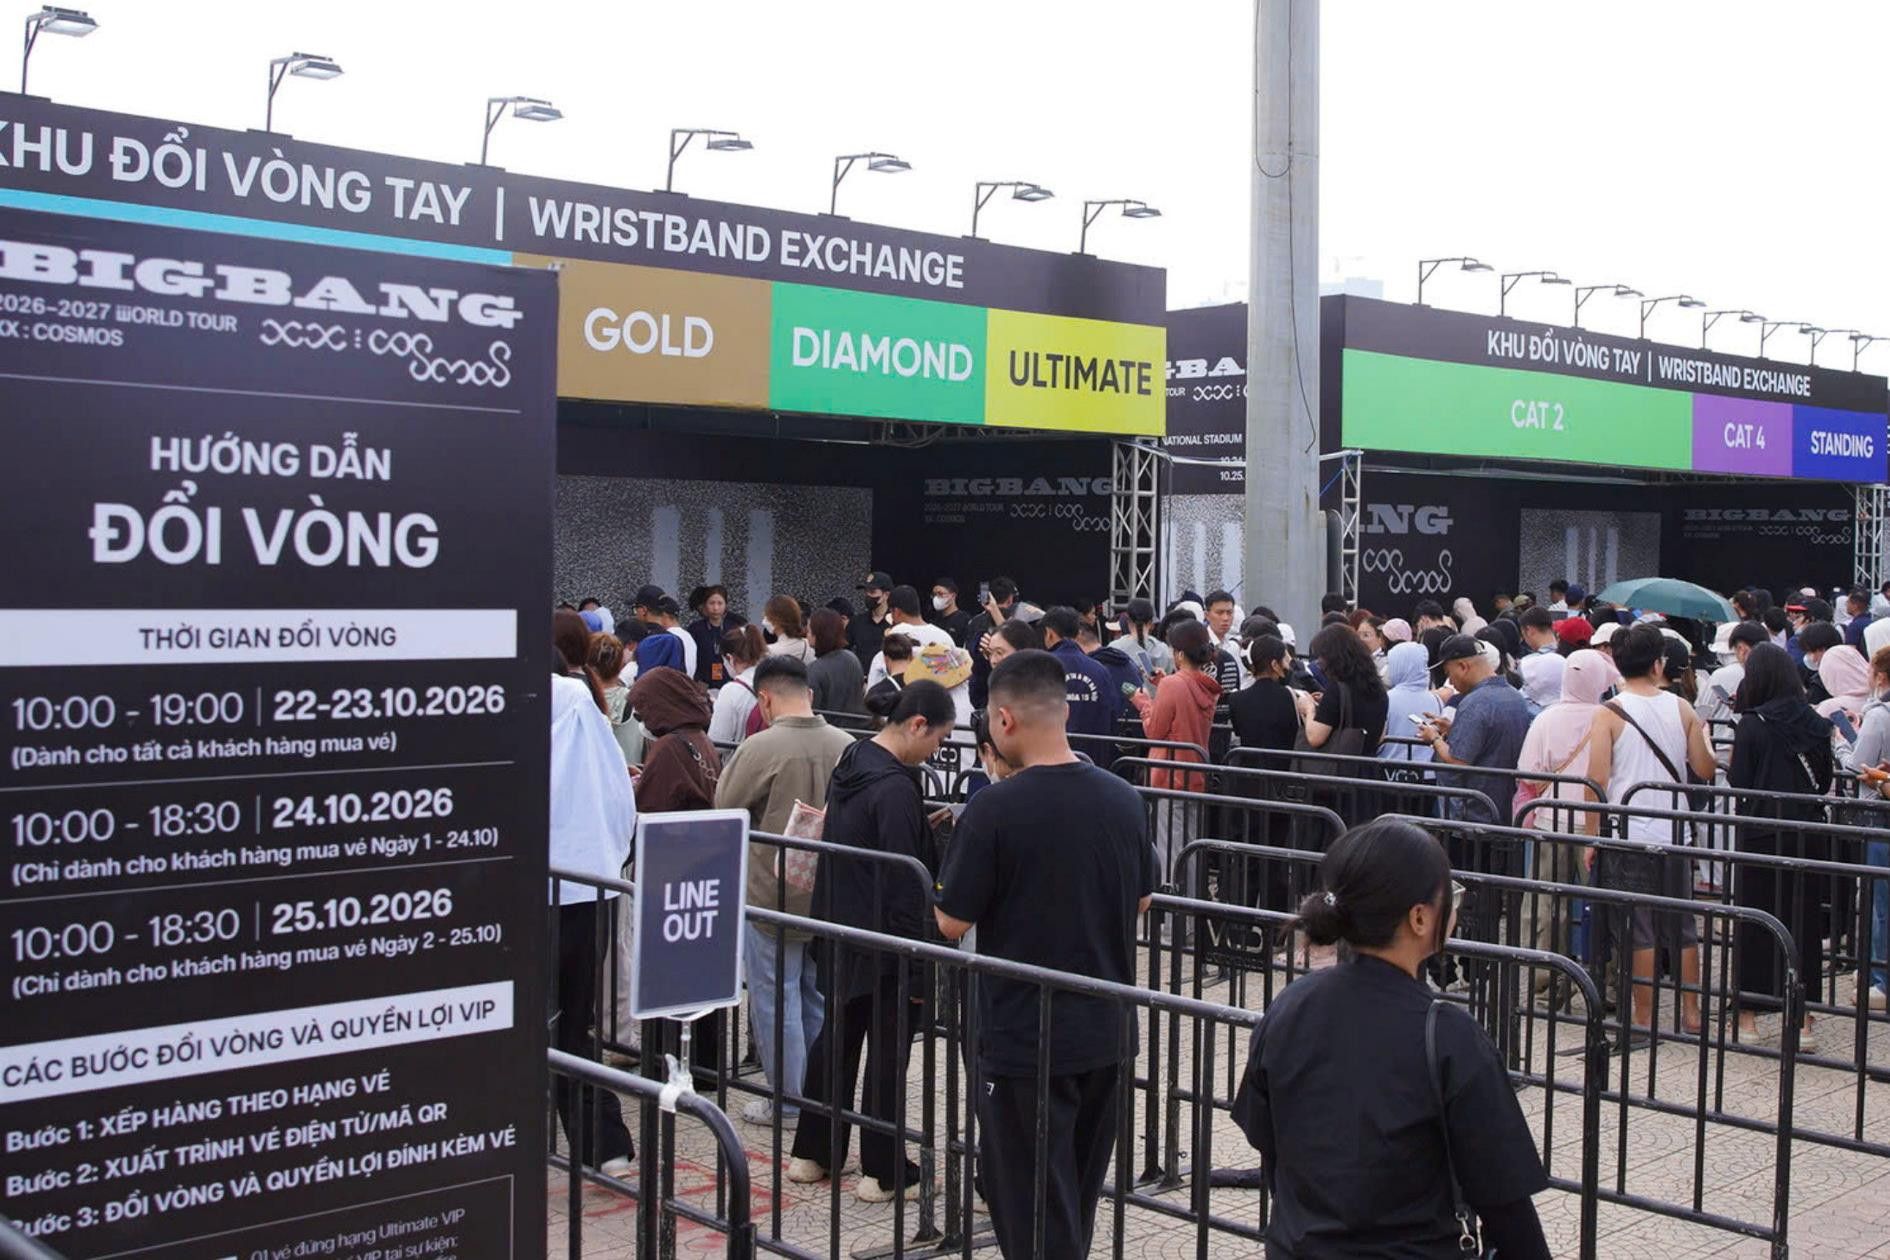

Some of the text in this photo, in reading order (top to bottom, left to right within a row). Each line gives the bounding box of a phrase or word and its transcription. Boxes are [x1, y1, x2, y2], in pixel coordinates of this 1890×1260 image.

[109, 127, 206, 191] ĐỔI
[222, 148, 371, 214] VÒNG
[384, 177, 472, 226] TAY
[528, 197, 771, 262] WRISTBAND
[779, 231, 965, 289] EXCHANGE
[0, 240, 524, 329] BIGBANG
[0, 293, 110, 321] 026-2027
[186, 311, 238, 332] TOUR
[583, 307, 715, 359] GOLD
[792, 327, 974, 382] DIAMOND
[1009, 350, 1152, 396] ULTIMATE
[1487, 329, 1526, 359] KHU
[1529, 327, 1559, 363] ĐỔI
[1563, 336, 1610, 371] VÒNG
[1613, 347, 1641, 375] TAY
[1658, 355, 1742, 390] WRISTBAND
[1743, 368, 1812, 397] EXCHANGE
[1203, 433, 1243, 445] STADIUM
[1510, 399, 1565, 432] CAT 2
[1724, 422, 1766, 450] CAT 4
[150, 431, 391, 480] HƯỚNG DẪN
[1810, 430, 1875, 459] STANDING
[924, 477, 1114, 496] BIGBANG
[89, 481, 439, 568] ĐỔI VÒNG
[1683, 509, 1851, 521] BIGBANG
[139, 618, 397, 650] THỜI GIAN ĐỔI VÒNG
[13, 695, 116, 731] 10:00
[150, 692, 244, 726] 19:00
[273, 685, 506, 721] 22-23.10.2026
[12, 745, 81, 770] (Dành
[85, 744, 128, 763] cho
[132, 739, 163, 761] tất
[198, 738, 261, 757] khách
[266, 736, 317, 758] hàng
[320, 737, 363, 752] mua
[367, 731, 397, 752] vé)
[12, 808, 115, 847] 10:00
[149, 801, 241, 838] 18:30
[272, 788, 454, 830] 24.10.2026
[64, 858, 121, 880] dành
[125, 855, 167, 874] cho
[171, 847, 236, 871] khách
[240, 846, 292, 867] hàng
[296, 845, 339, 861] mua
[344, 836, 368, 856] vé
[370, 836, 419, 856] Ngày
[423, 833, 431, 850] 1
[446, 828, 499, 848] 24.10)
[664, 878, 720, 911] LINE
[12, 920, 115, 962] 10:00
[149, 909, 241, 947] 18:30
[271, 888, 453, 935] 25.10.2026
[663, 910, 719, 943] OUT
[64, 967, 121, 990] dành
[125, 963, 168, 984] cho
[171, 954, 236, 978] khách
[240, 949, 292, 970] hàng
[296, 946, 340, 964] mua
[344, 939, 367, 957] vé
[370, 936, 418, 956] Ngày
[422, 932, 434, 949] 2
[449, 923, 502, 946] 25.10)
[2, 999, 497, 1088] CÁC BƯỚC ĐỔI VÒNG VÀ QUYỀN LỢI VIP
[6, 1067, 391, 1153] Bước 1: XẾP HÀNG THEO HẠNG VÉ
[6, 1102, 448, 1197] Bước 2: XUẤT TRÌNH VÉ ĐIỆN TỬ/MÃ QR
[76, 1206, 99, 1228] 3:
[104, 1189, 149, 1223] ĐỔI
[154, 1184, 225, 1214] VÒNG
[230, 1171, 262, 1198] VÀ
[266, 1154, 345, 1191] QUYỀN
[348, 1151, 383, 1178] LỢI
[386, 1142, 437, 1170] ĐÍNH
[440, 1132, 486, 1159] KÈM
[489, 1123, 517, 1147] VÉ
[337, 1231, 376, 1246] hạng
[379, 1215, 439, 1239] Ultimate
[441, 1207, 466, 1225] VIP
